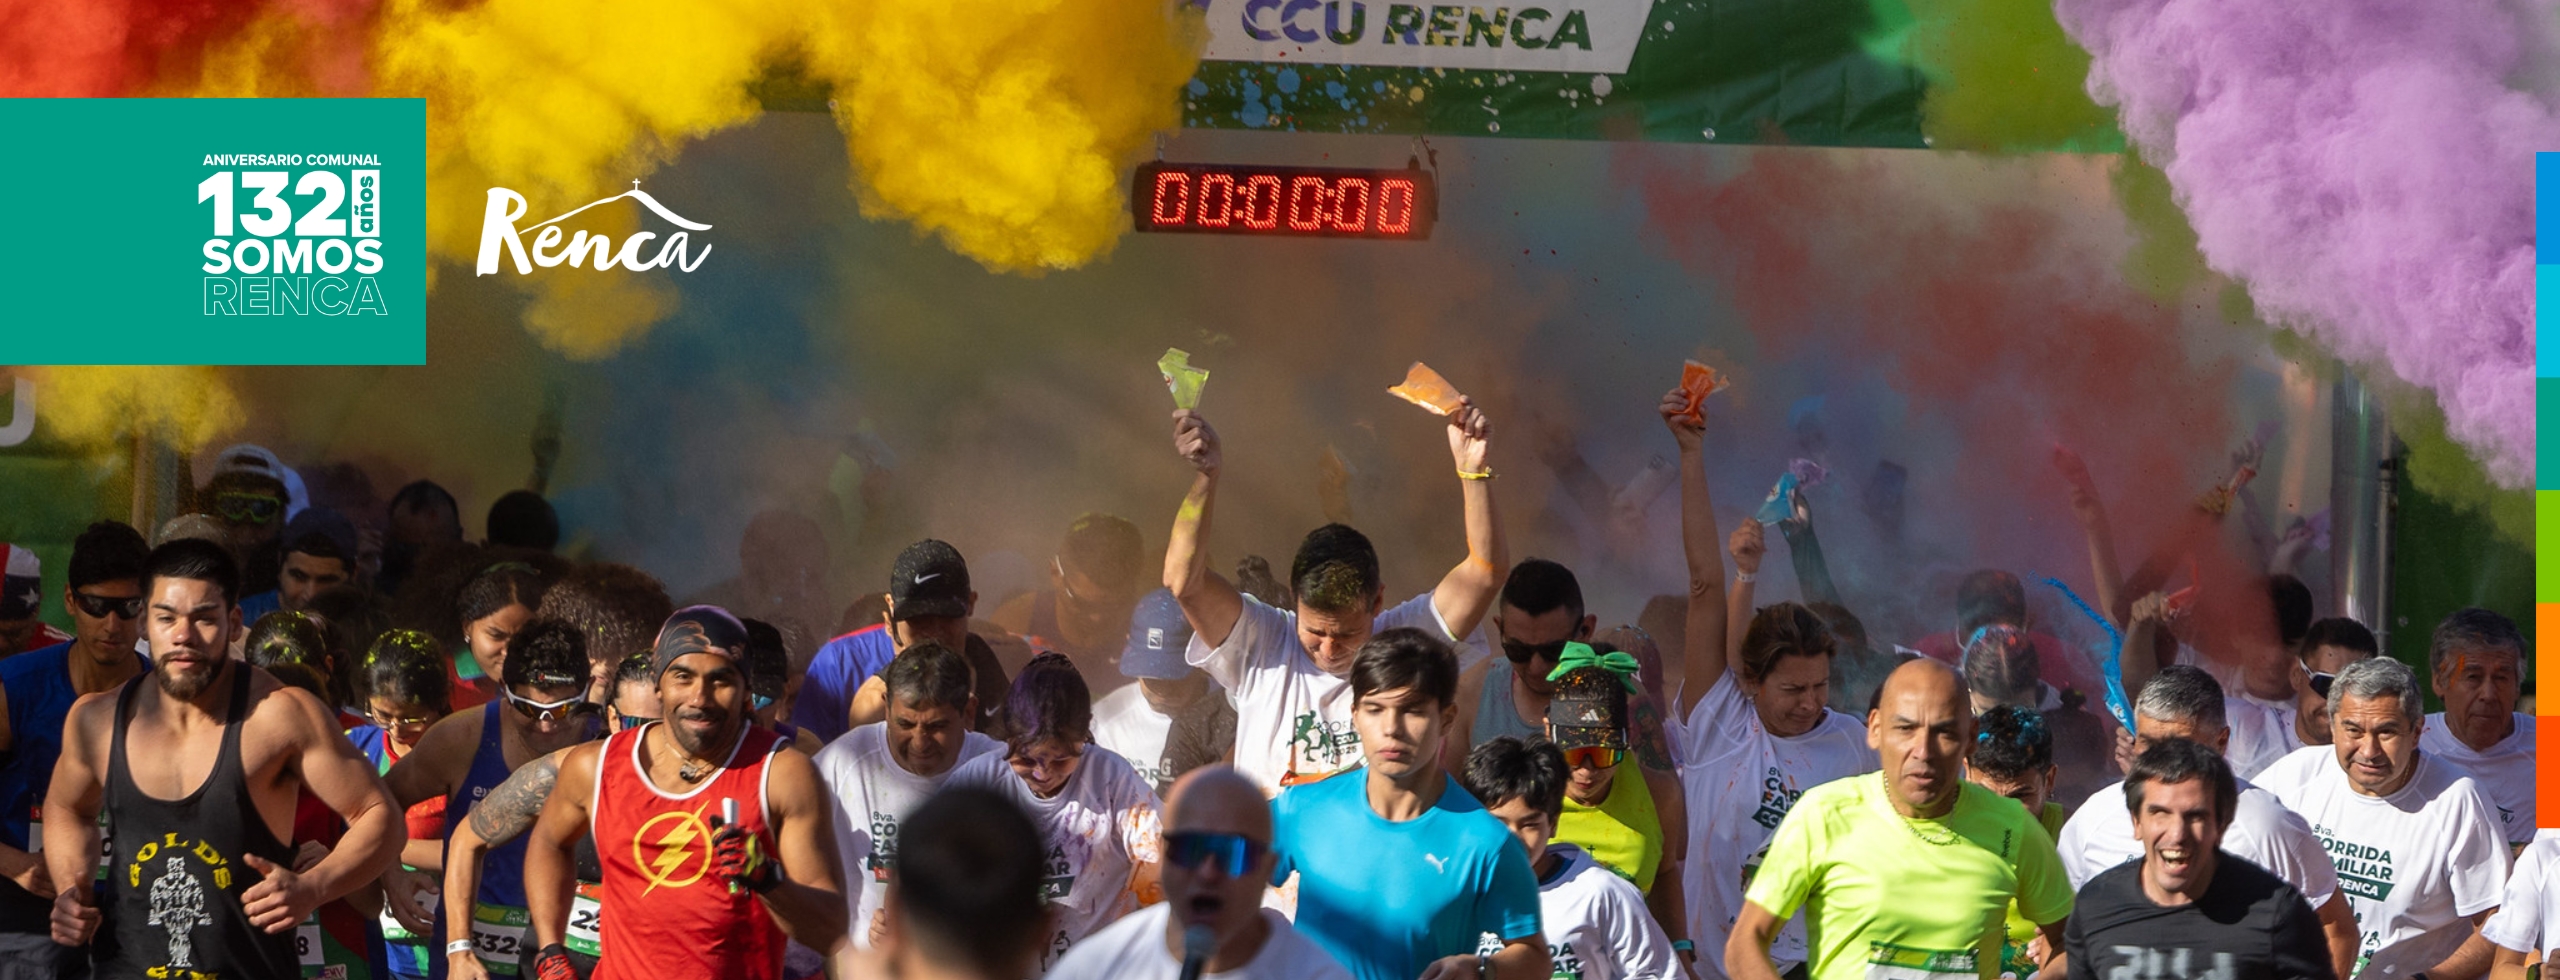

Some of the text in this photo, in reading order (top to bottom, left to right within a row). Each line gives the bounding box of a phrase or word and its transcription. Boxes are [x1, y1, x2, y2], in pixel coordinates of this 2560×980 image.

[1241, 0, 1594, 51] CCU RENCA
[872, 822, 900, 837] CO
[2315, 834, 2393, 864] ORRIDA
[2330, 856, 2394, 881] MILIAR
